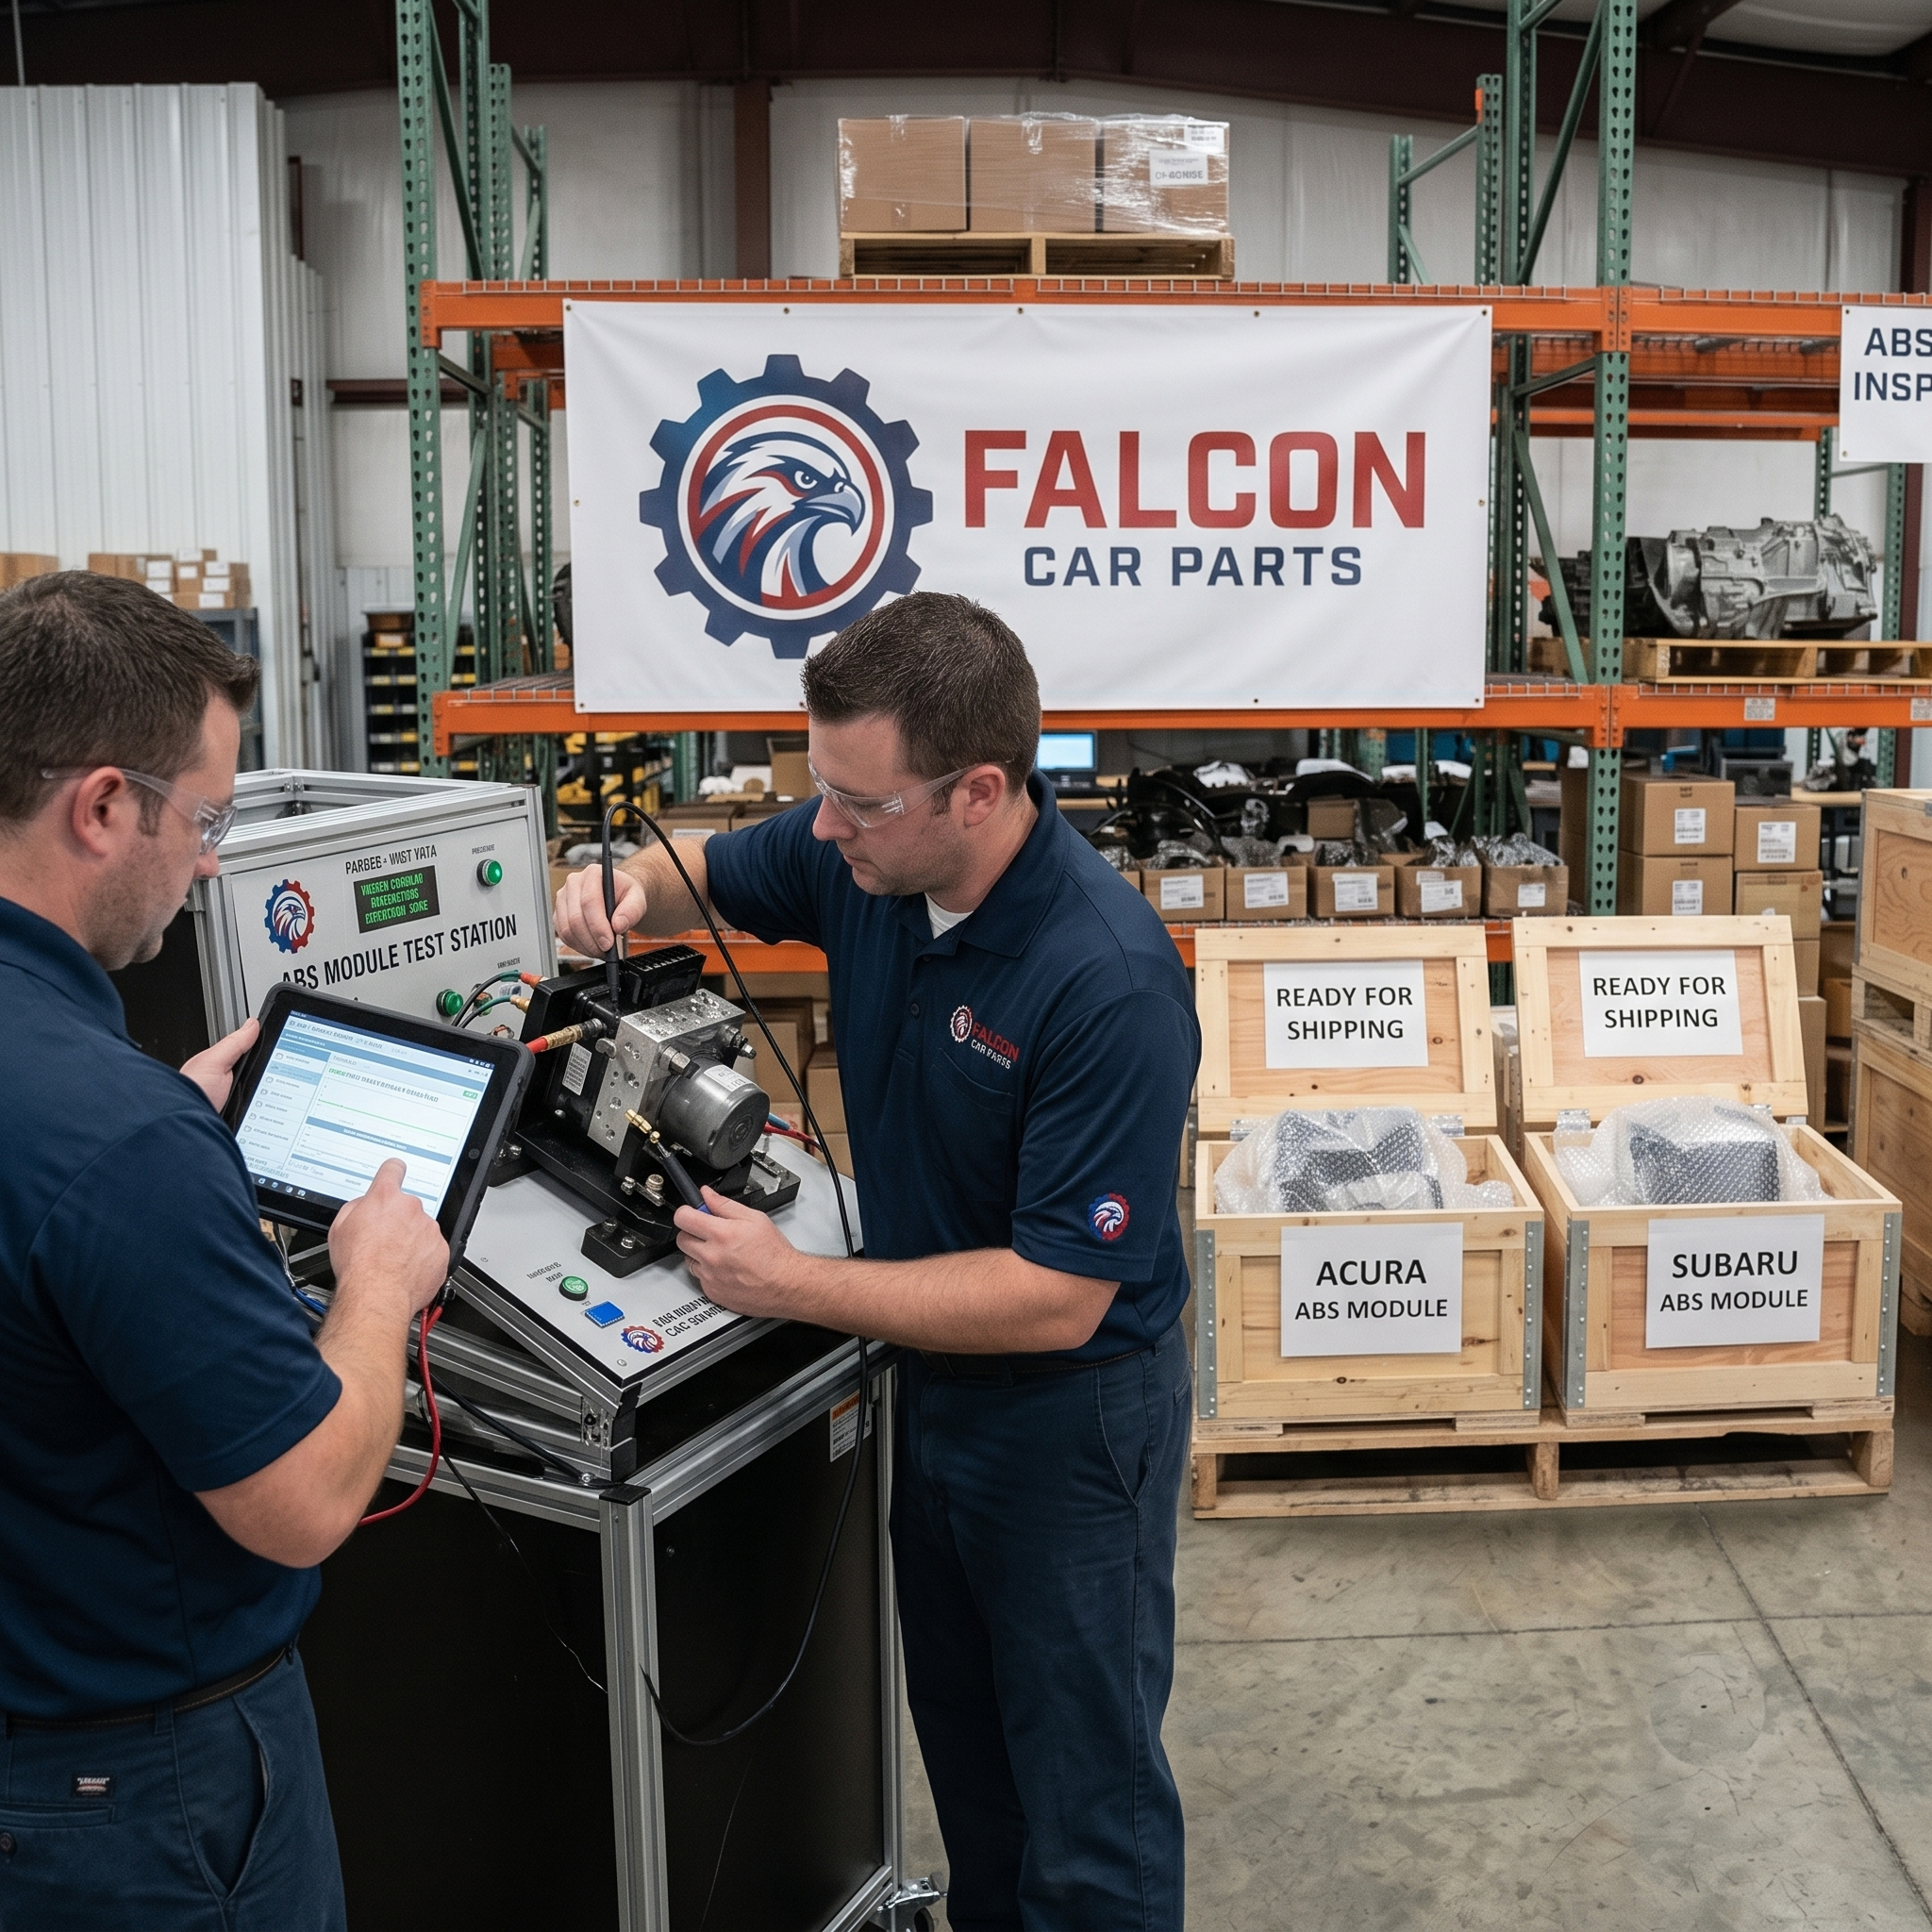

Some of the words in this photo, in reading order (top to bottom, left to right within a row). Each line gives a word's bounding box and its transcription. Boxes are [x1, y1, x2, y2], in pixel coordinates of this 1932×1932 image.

[1864, 327, 1932, 357] ABS
[1855, 372, 1932, 402] INSP
[964, 429, 1426, 529] FALCON
[1024, 546, 1142, 587] CAR
[1171, 546, 1362, 587] PARTS
[324, 943, 400, 986] MODULE
[403, 932, 445, 964] TEST
[450, 913, 518, 953] STATION
[1276, 987, 1357, 1008] READY
[1365, 986, 1413, 1007] FOR
[1593, 976, 1672, 996] READY
[1679, 975, 1727, 996] FOR
[1287, 1019, 1405, 1041] SHIPPING
[1604, 1008, 1719, 1029] SHIPPING
[971, 1039, 987, 1055] CAR
[972, 1022, 1020, 1062] FALCON
[1316, 1258, 1427, 1287] ACURA
[1672, 1250, 1799, 1279] SUBARU
[1294, 1300, 1341, 1321] ABS
[1346, 1298, 1449, 1320] MODULE
[1659, 1291, 1704, 1312] ABS
[1710, 1289, 1809, 1311] MODULE
